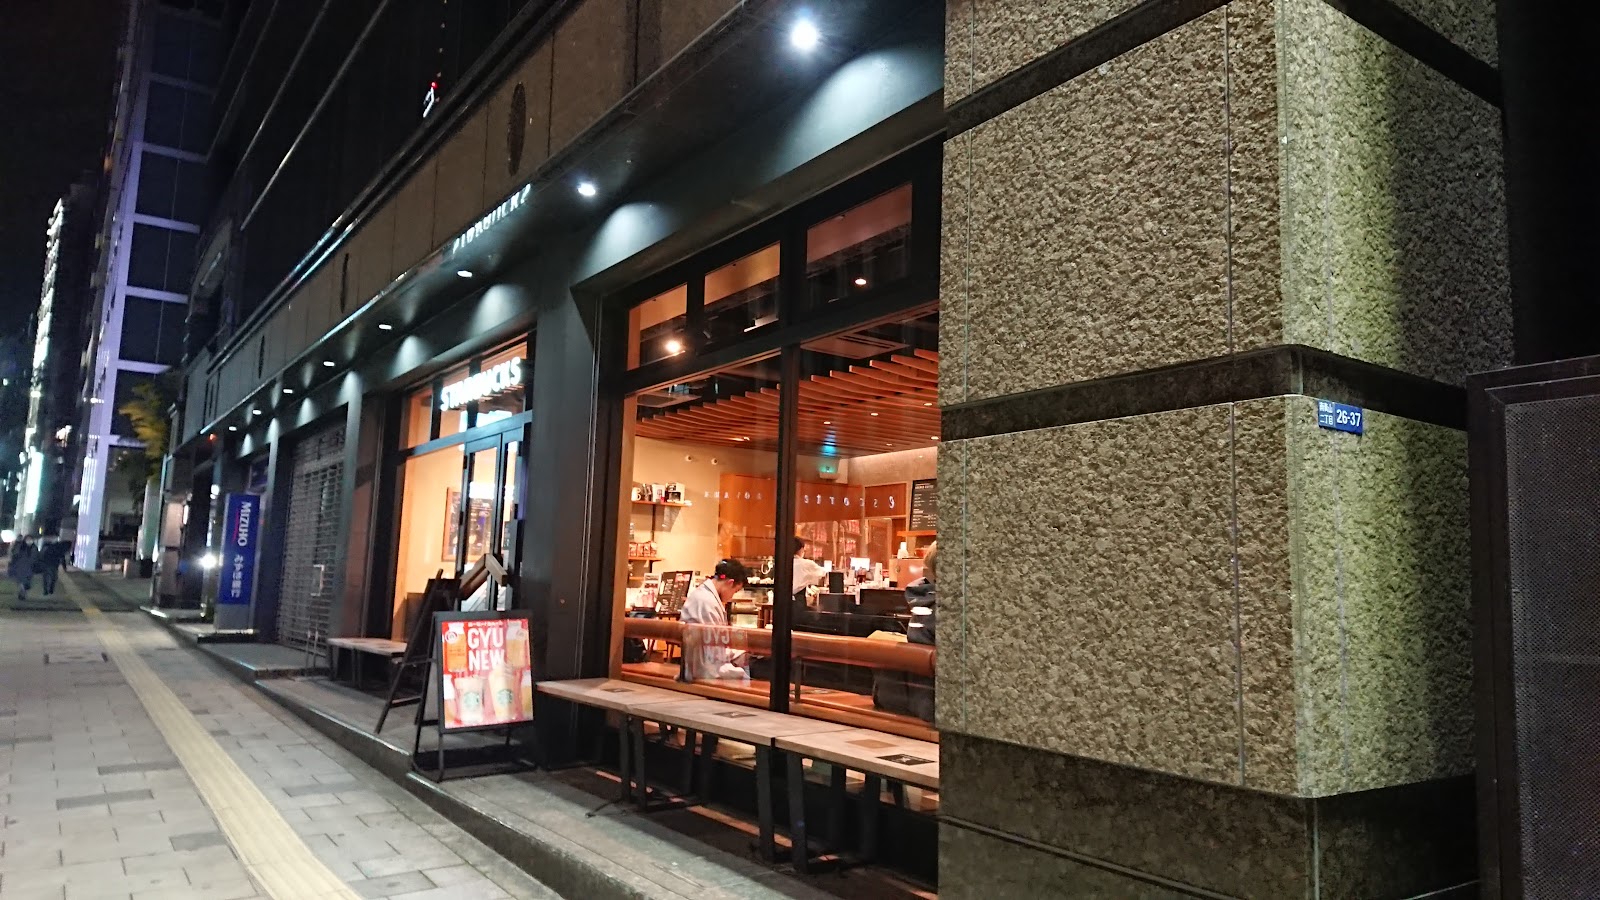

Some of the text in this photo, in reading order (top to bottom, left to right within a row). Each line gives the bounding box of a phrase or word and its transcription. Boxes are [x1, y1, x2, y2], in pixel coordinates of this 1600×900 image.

[440, 356, 521, 411] STARBUCKS
[1319, 414, 1333, 425] 二丁目
[1336, 408, 1361, 427] 26-37
[238, 502, 252, 546] MIZUHO
[467, 628, 504, 648] GYU
[469, 650, 505, 671] NEW
